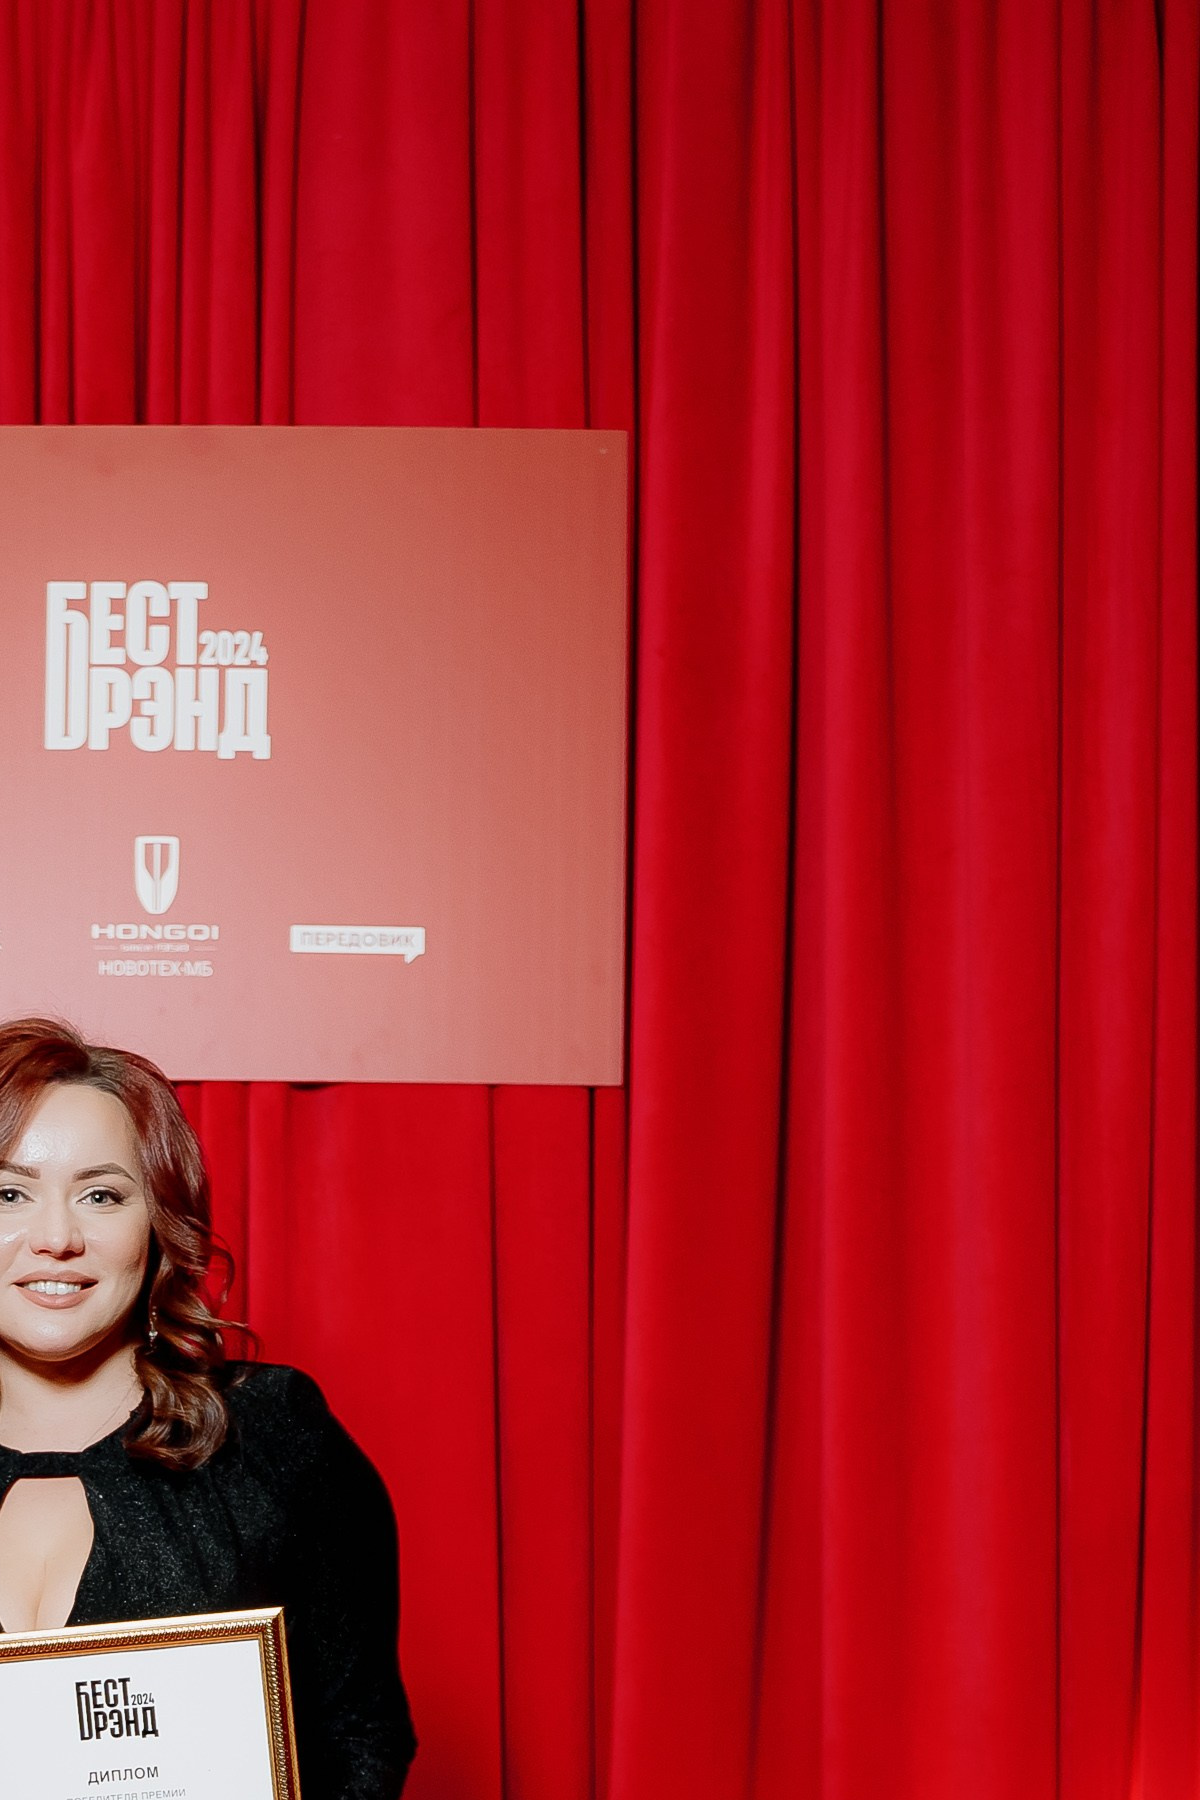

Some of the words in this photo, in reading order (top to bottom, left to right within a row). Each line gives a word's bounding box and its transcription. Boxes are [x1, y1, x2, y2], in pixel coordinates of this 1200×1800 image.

[199, 630, 269, 666] 2024
[90, 923, 220, 941] HONGQI
[302, 931, 416, 948] ПЕРЕДОВИК
[130, 1692, 155, 1706] 2024
[87, 1766, 159, 1786] ДИПЛОМ
[141, 1788, 186, 1800] ПРЕМИИ
